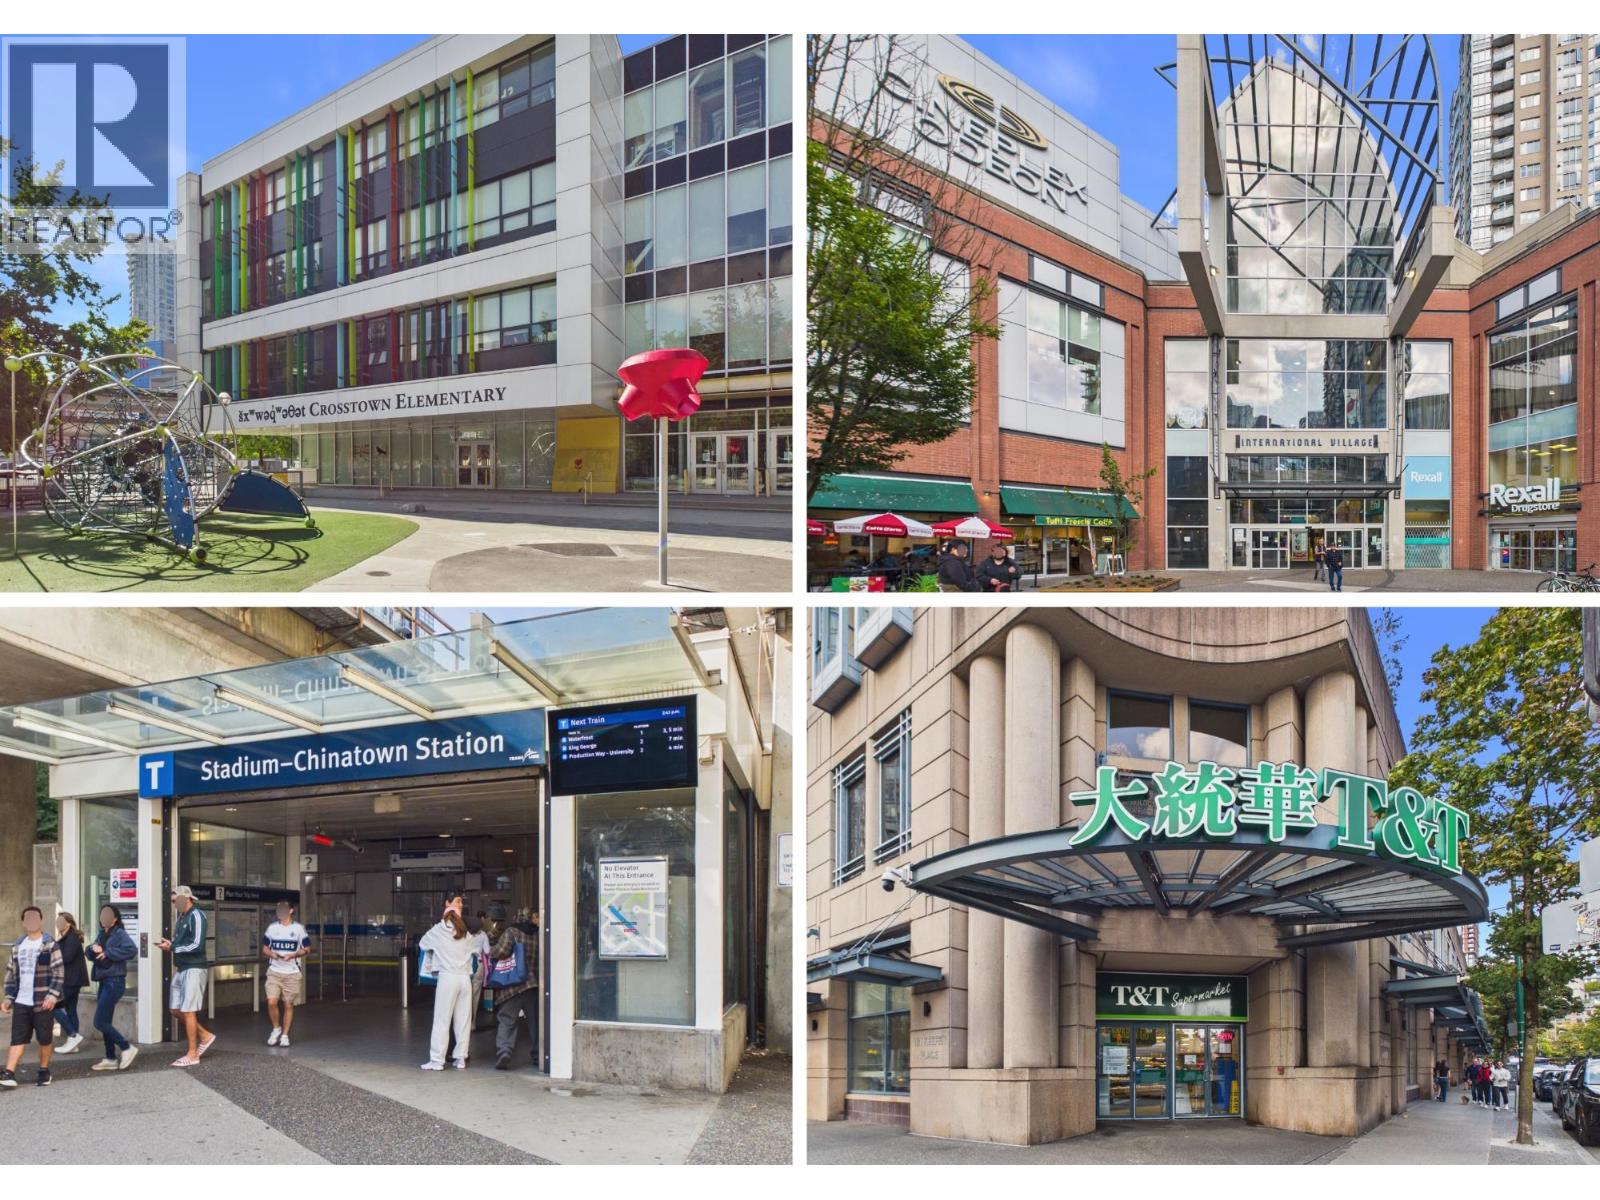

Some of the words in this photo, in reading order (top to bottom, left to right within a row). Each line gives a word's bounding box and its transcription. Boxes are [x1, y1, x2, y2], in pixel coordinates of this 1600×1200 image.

[882, 71, 1088, 205] CINEPLEX
[914, 116, 1067, 213] ODEON
[1240, 438, 1323, 447] INTERNATIONAL
[1330, 438, 1374, 447] VILLAGE
[1410, 470, 1443, 483] Rexall
[1490, 477, 1561, 507] Rexall
[1511, 501, 1560, 514] Drugstore
[570, 718, 586, 726] Next
[588, 716, 605, 725] Train
[415, 731, 504, 760] Station
[568, 734, 594, 742] Waterfront
[568, 744, 579, 752] King
[579, 743, 597, 751] George
[569, 752, 594, 760] Production
[595, 750, 606, 758] Way
[609, 748, 634, 757] University
[145, 760, 165, 790] T
[1067, 760, 1319, 846] 大統華
[1320, 767, 1471, 875] T&T
[1111, 985, 1170, 1007] T&T
[1170, 982, 1231, 1010] Supermarket
